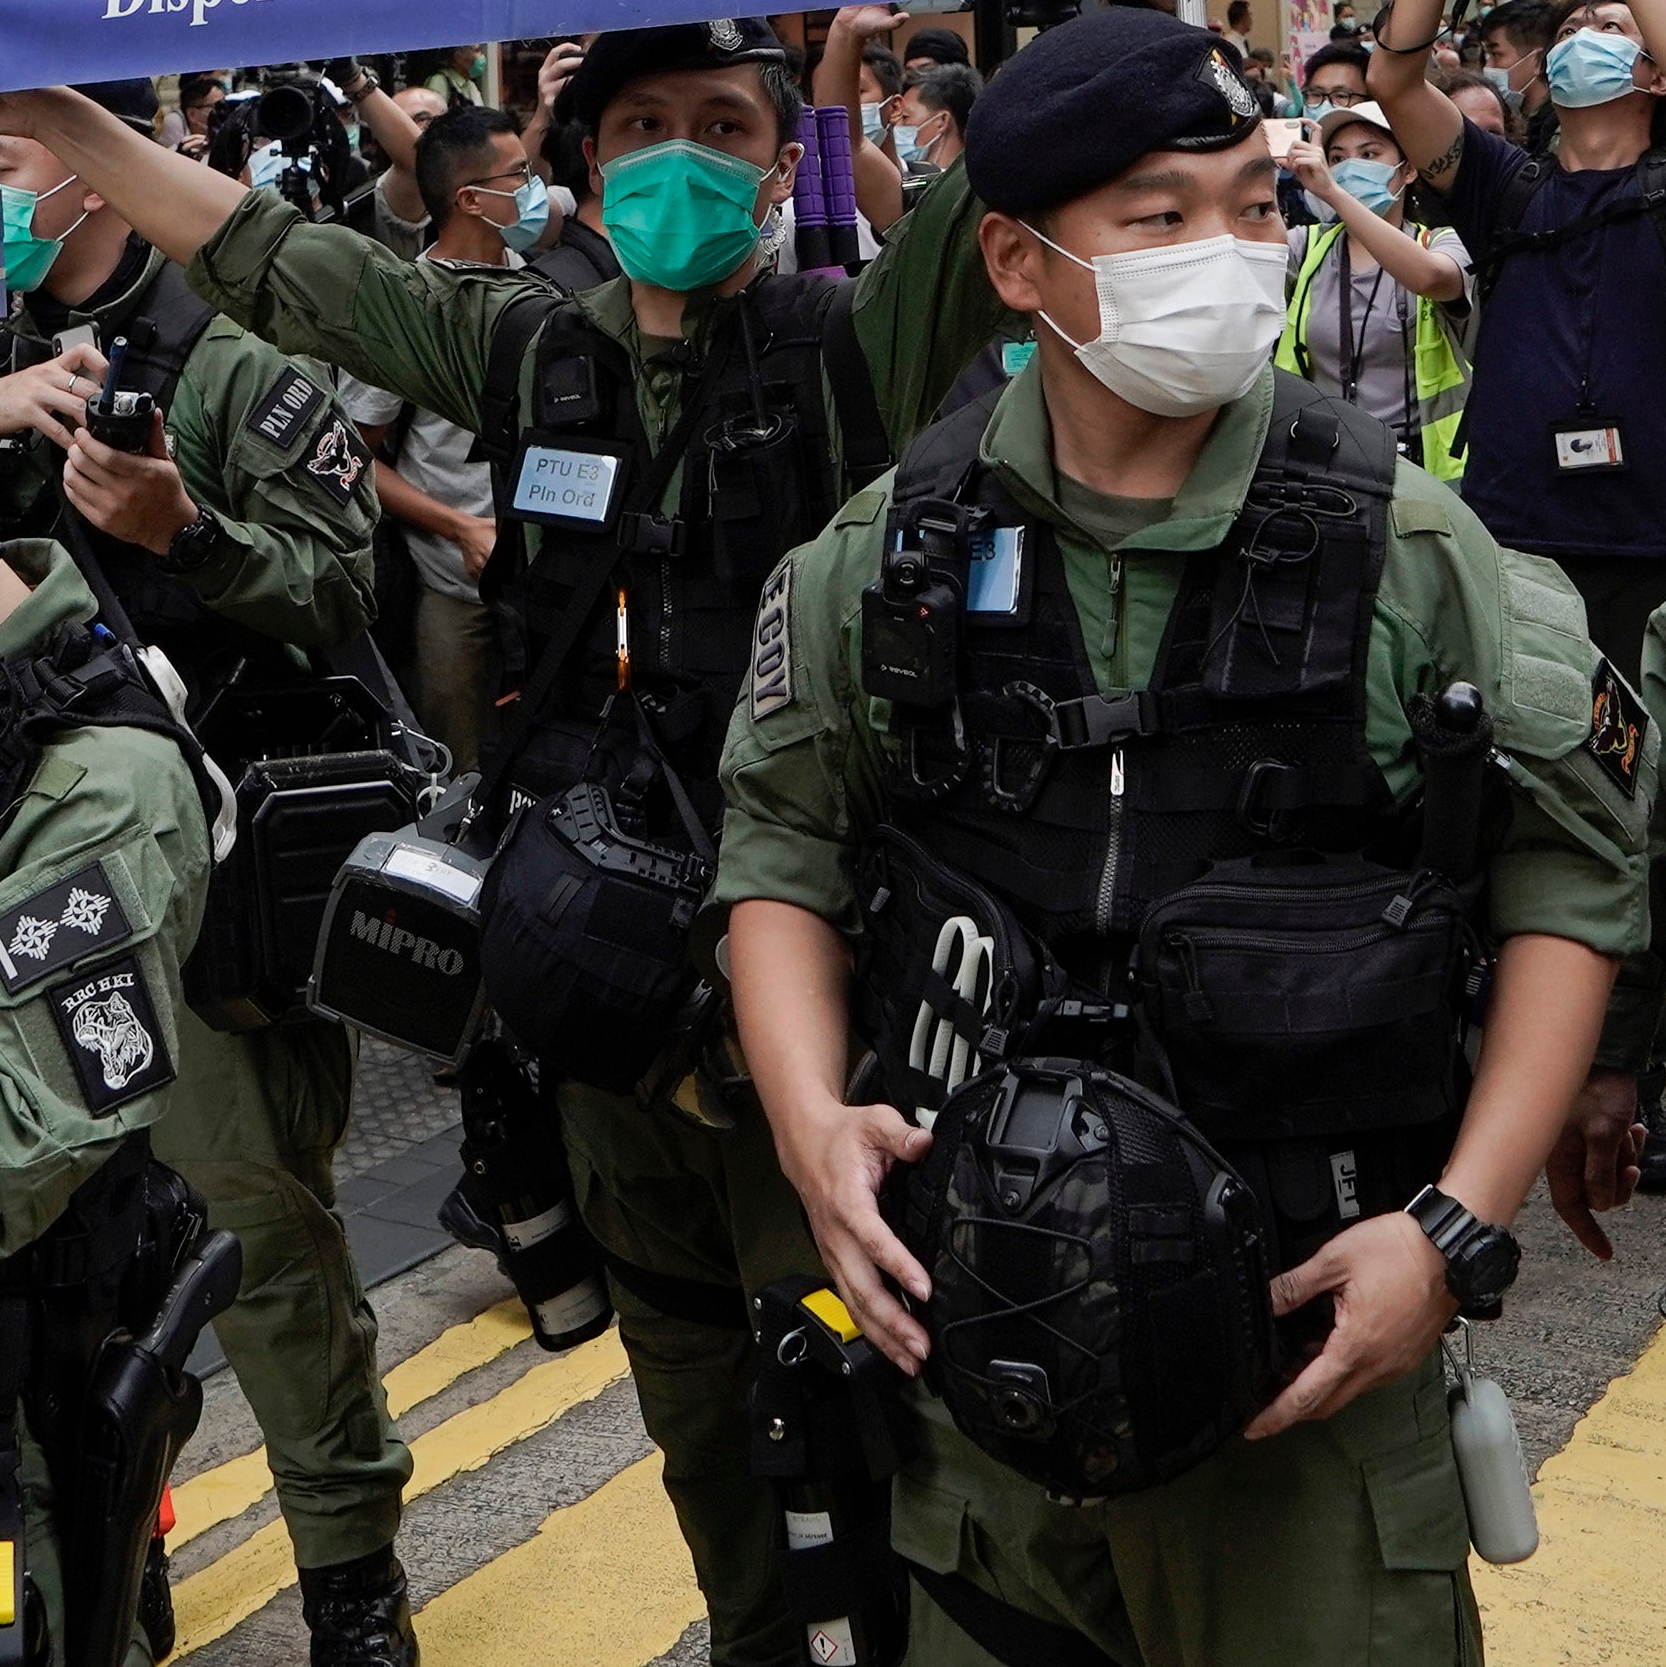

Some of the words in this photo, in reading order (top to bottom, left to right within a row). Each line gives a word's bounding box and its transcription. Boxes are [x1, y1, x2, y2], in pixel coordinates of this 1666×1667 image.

[258, 408, 290, 440] PLN
[283, 376, 315, 411] ORD
[528, 483, 559, 504] Pln
[563, 487, 596, 509] Ord
[535, 456, 571, 481] PTU
[575, 461, 600, 483] E3
[753, 602, 789, 707] COY
[349, 909, 465, 977] MIPRO
